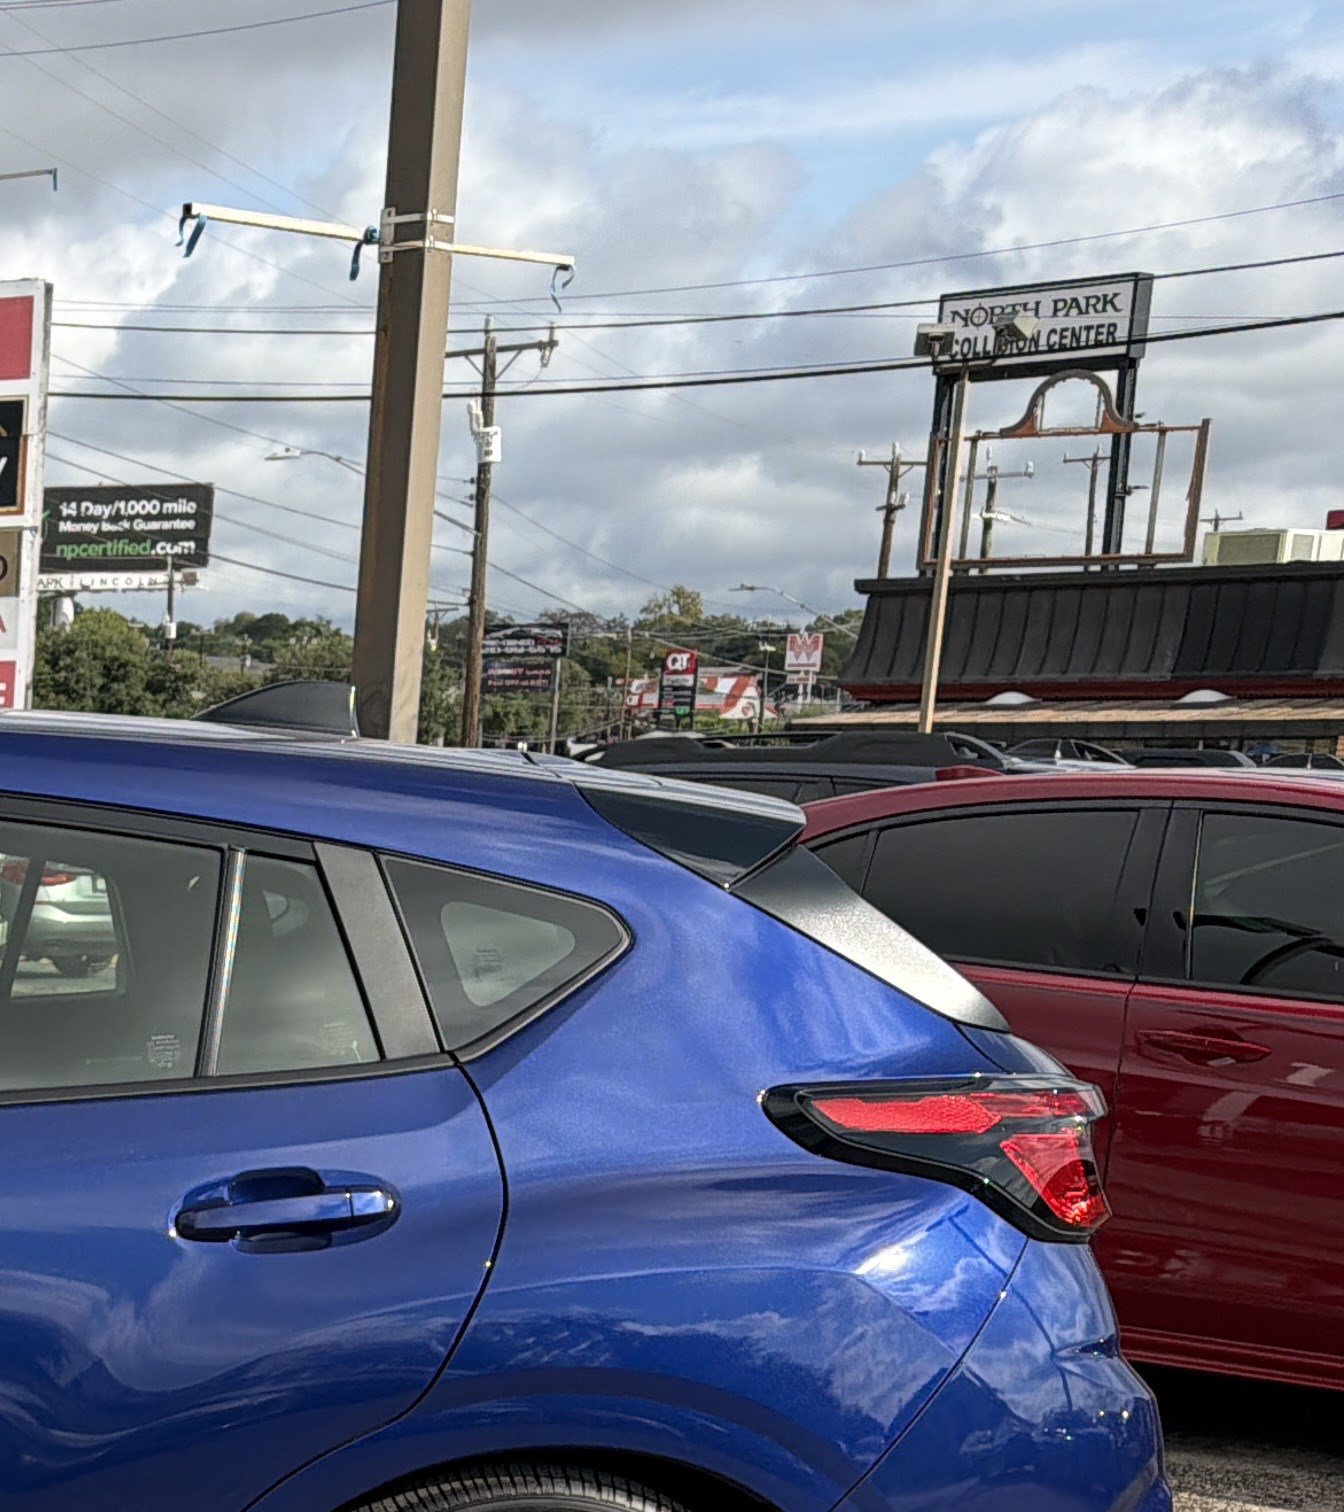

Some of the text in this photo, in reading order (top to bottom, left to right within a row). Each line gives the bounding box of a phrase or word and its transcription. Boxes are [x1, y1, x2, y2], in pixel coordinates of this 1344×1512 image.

[1051, 292, 1124, 318] PARK
[1046, 321, 1119, 351] CENTER
[162, 498, 198, 515] mile
[58, 520, 100, 535] Money
[132, 518, 197, 531] Guarantee
[55, 539, 196, 561] npcertified.com
[665, 652, 691, 672] QT
